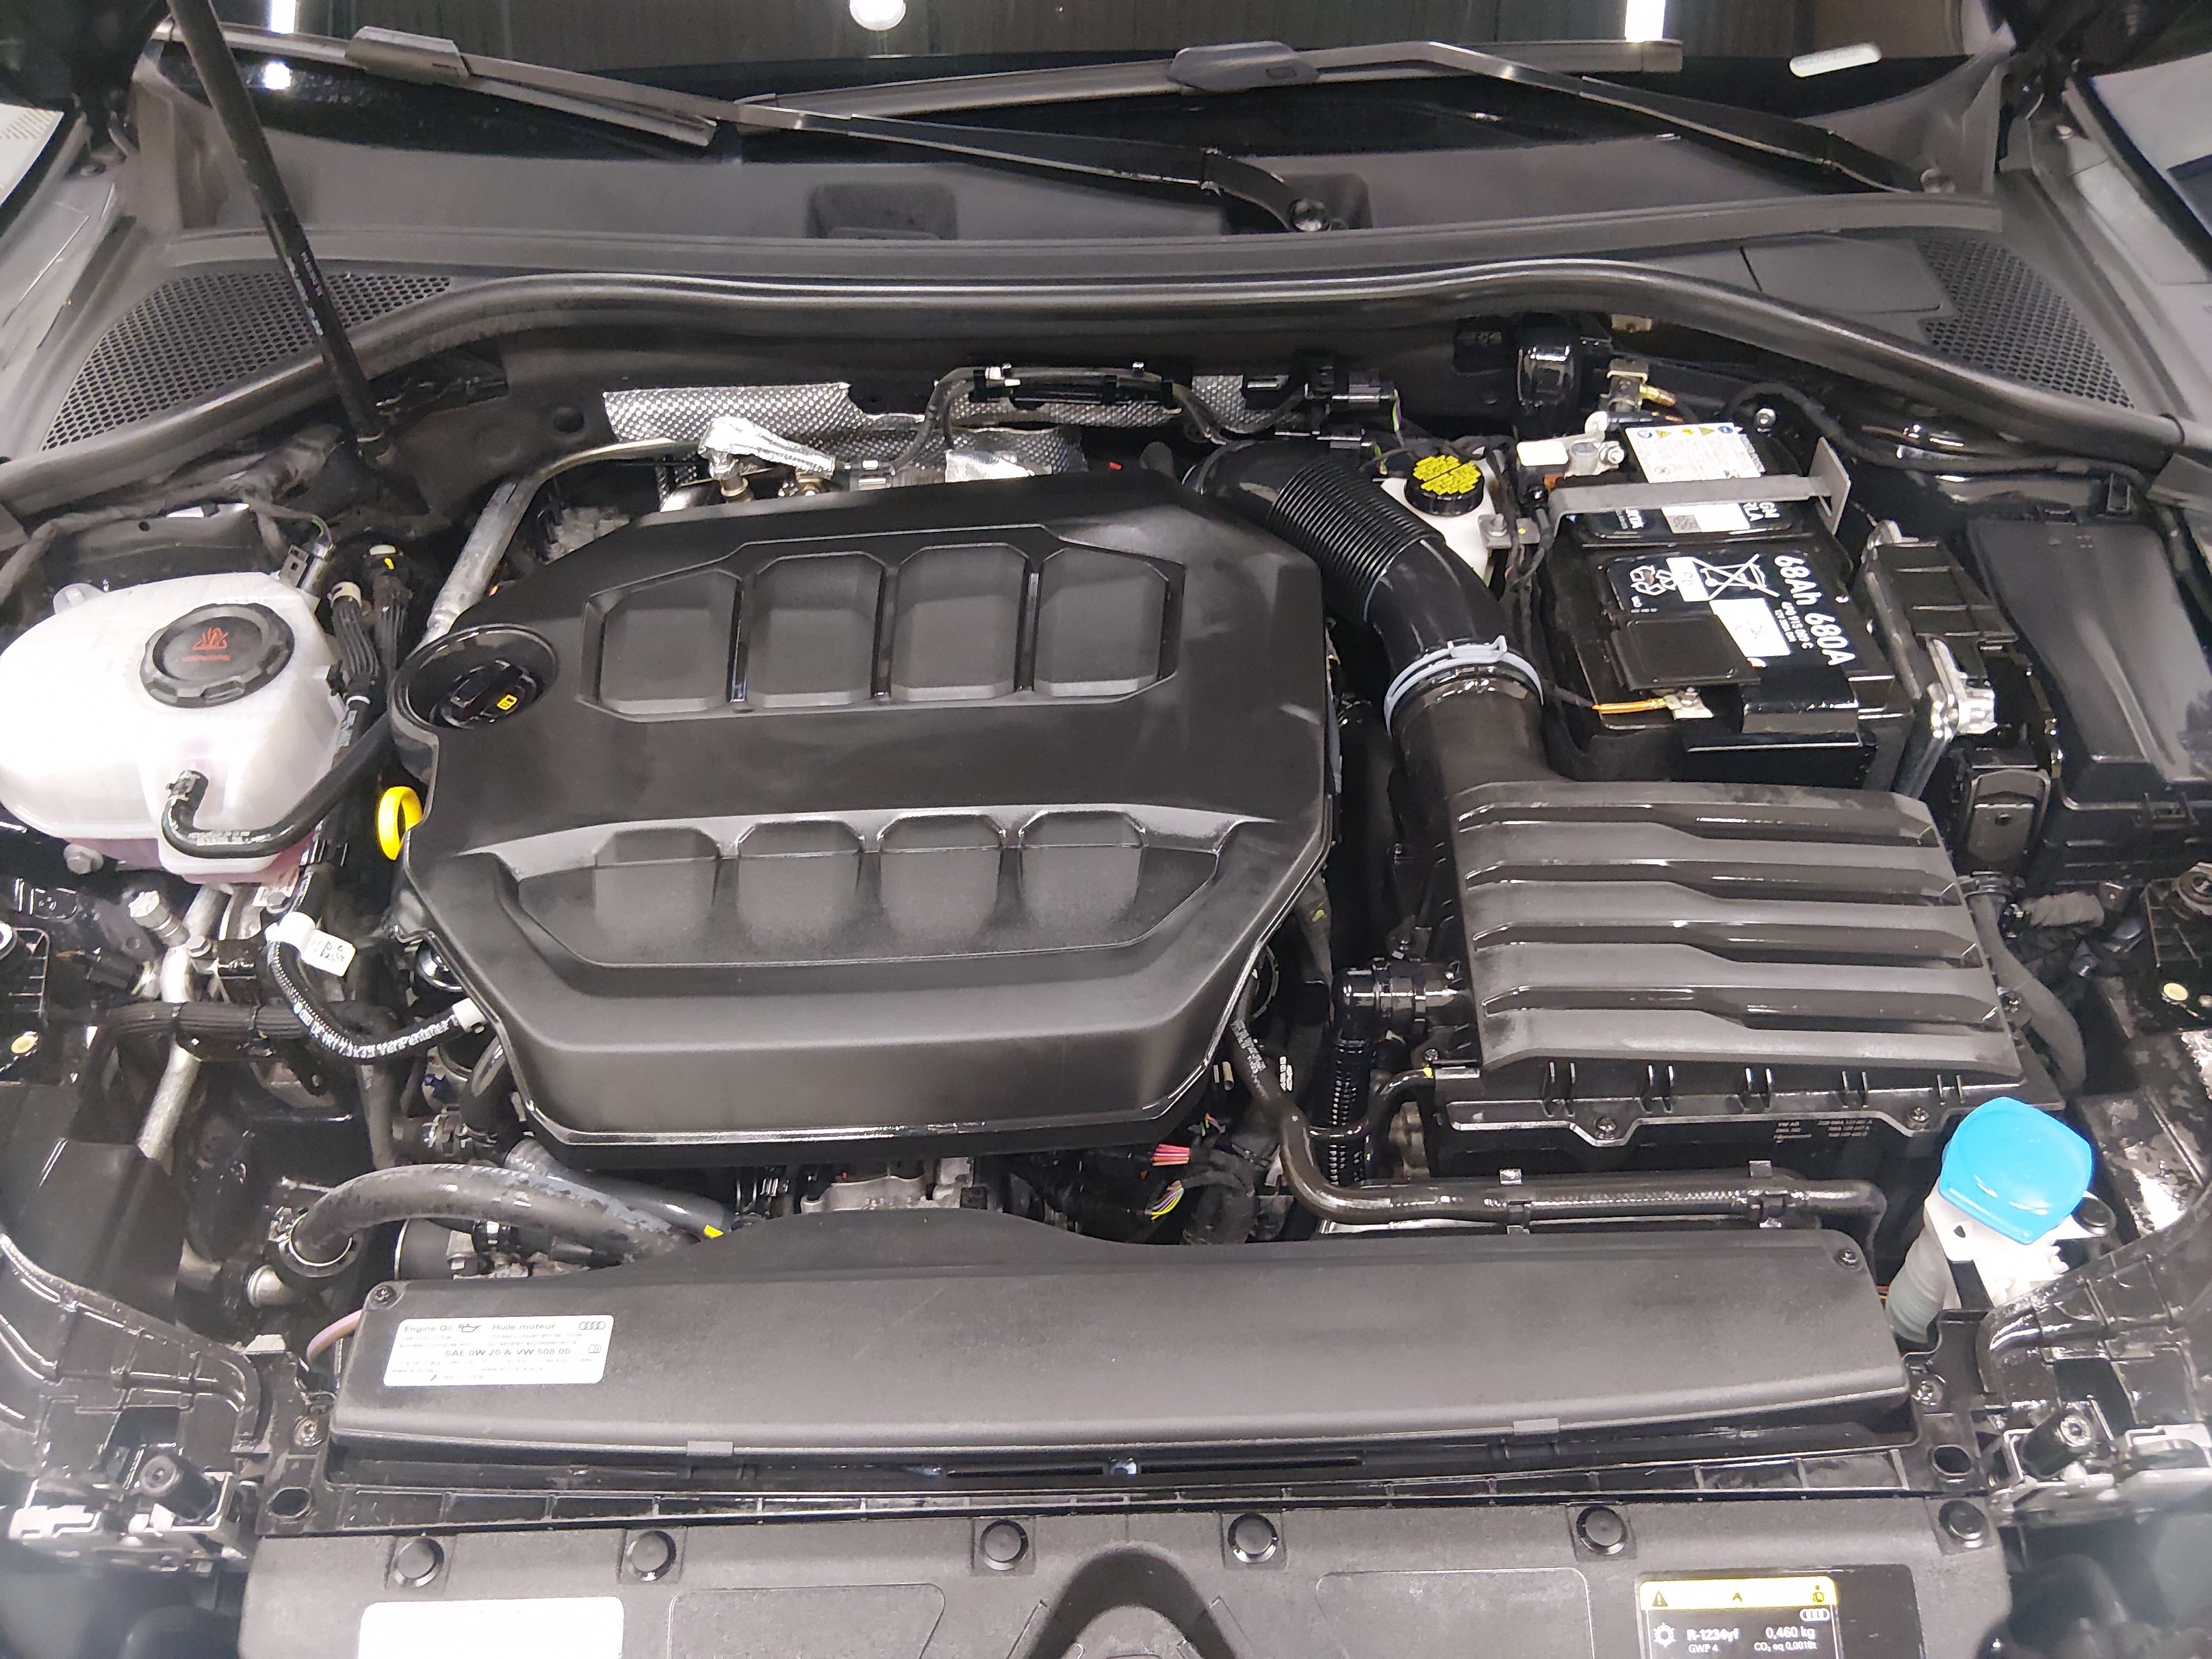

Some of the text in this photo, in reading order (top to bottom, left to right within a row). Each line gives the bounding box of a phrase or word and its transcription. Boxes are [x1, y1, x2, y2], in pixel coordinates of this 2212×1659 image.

[1774, 554, 1856, 666] 68Ah 680A
[1686, 1625, 1816, 1642] R-1234yf 0,460 kg
[1688, 1643, 1711, 1653] GWP
[1712, 1643, 1719, 1652] 4
[1772, 1642, 1784, 1651] eq
